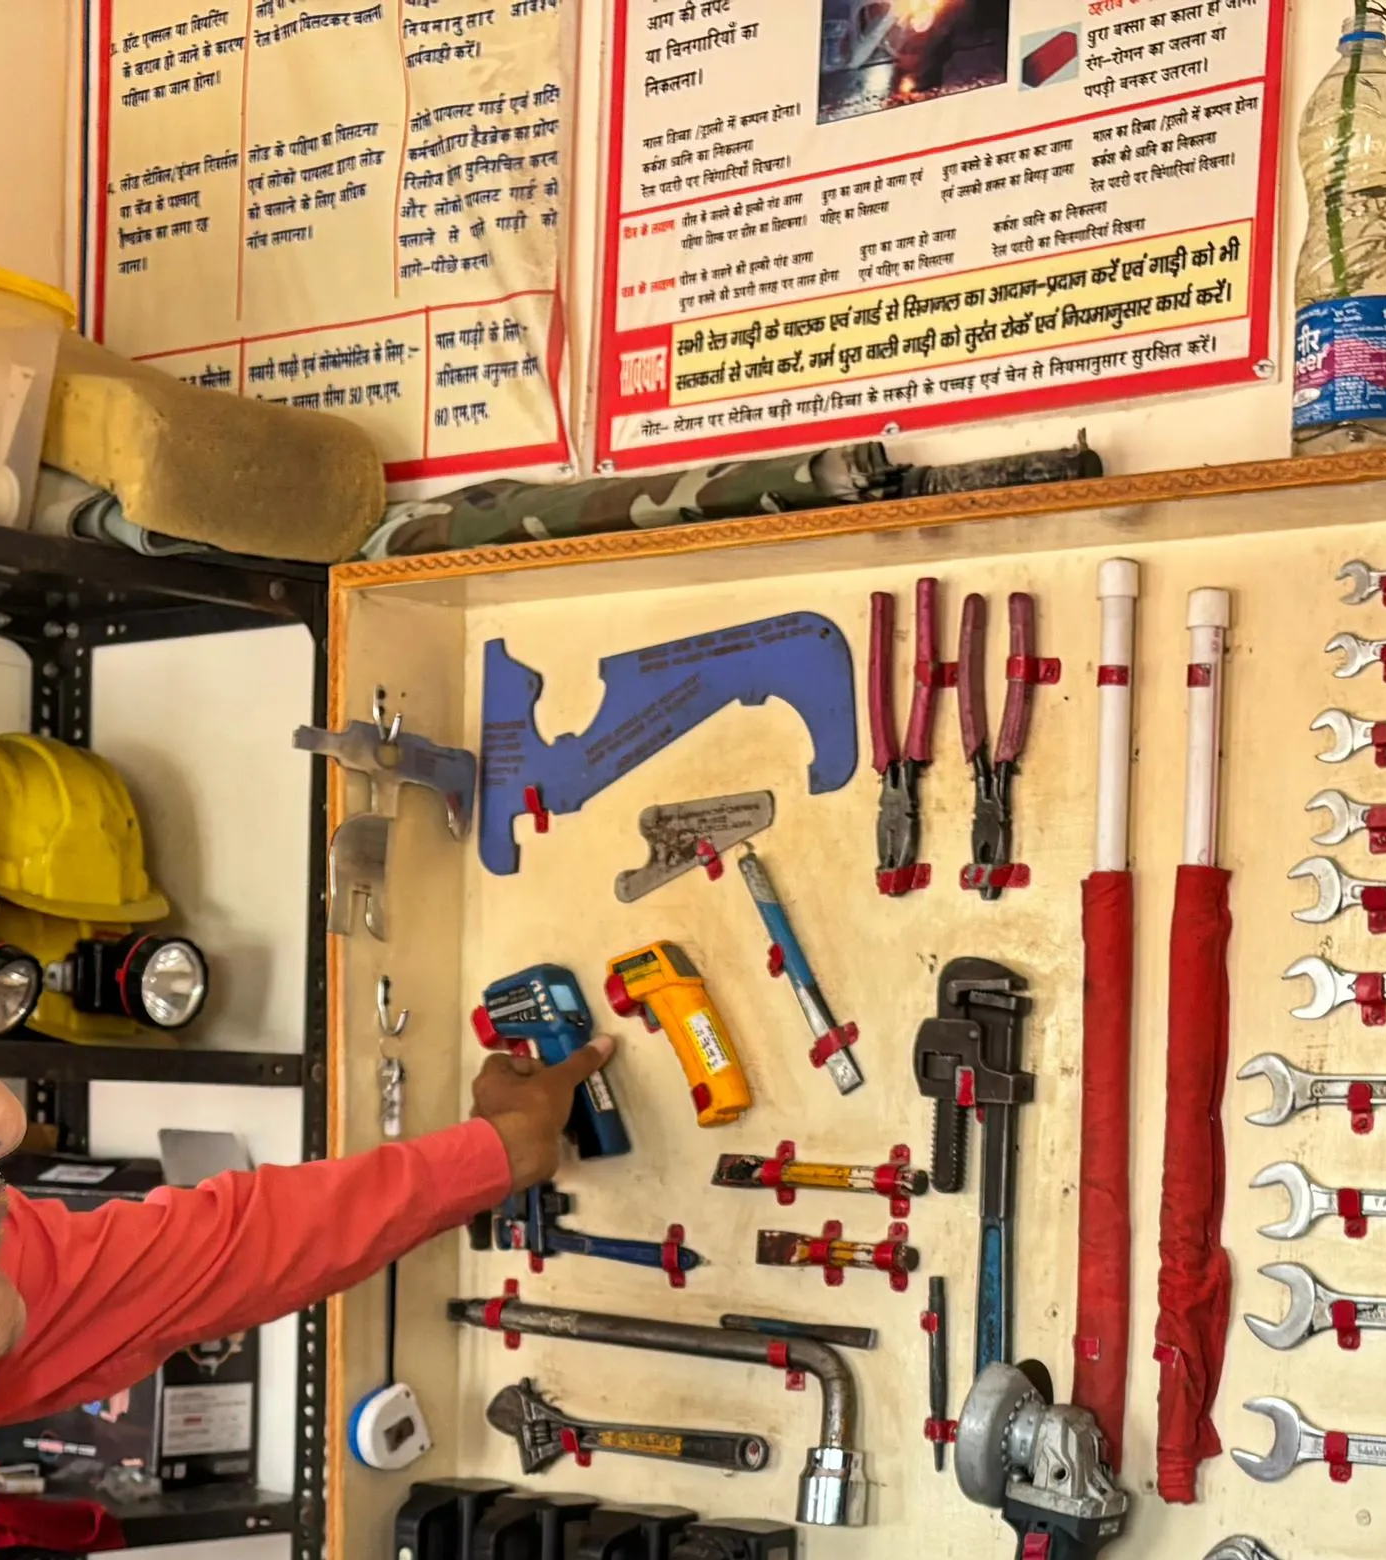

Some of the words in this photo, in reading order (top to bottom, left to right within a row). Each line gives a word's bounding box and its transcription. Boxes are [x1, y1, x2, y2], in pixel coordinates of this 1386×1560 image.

[645, 48, 661, 64] या
[740, 23, 759, 40] का
[1148, 41, 1164, 57] का
[1211, 26, 1227, 42] या
[1149, 12, 1167, 28] का
[1169, 4, 1204, 23] काला
[677, 330, 704, 357] सभी
[707, 331, 728, 352] रेल
[731, 320, 761, 350] गाड़ी
[765, 319, 781, 341] के
[784, 315, 825, 338] चालक
[830, 305, 853, 332] एवं
[853, 299, 884, 326] गार्ड
[886, 298, 900, 321] से
[964, 288, 985, 307] का
[1091, 257, 1119, 285] करें
[1122, 253, 1148, 282] एवं
[1149, 245, 1187, 278] गाड़ी
[1191, 241, 1215, 268] को
[1219, 235, 1241, 263] भी
[728, 360, 742, 383] से
[745, 355, 774, 379] जांच
[809, 343, 837, 369] गर्म
[838, 345, 863, 373] धुरा
[866, 334, 899, 360] वाली
[903, 327, 935, 358] गाड़ी
[941, 324, 961, 348] को
[965, 319, 996, 353] तुरंत
[1001, 311, 1033, 340] रोकें
[1035, 307, 1061, 334] एवं
[1062, 297, 1153, 330] नियमानुसार
[1155, 283, 1193, 312] कार्य
[709, 413, 724, 428] पर
[867, 387, 879, 404] के
[922, 378, 935, 395] के
[980, 366, 1001, 390] एवं
[1005, 364, 1026, 382] चेन
[1033, 360, 1044, 380] से
[1131, 341, 1181, 370] सुरक्षित
